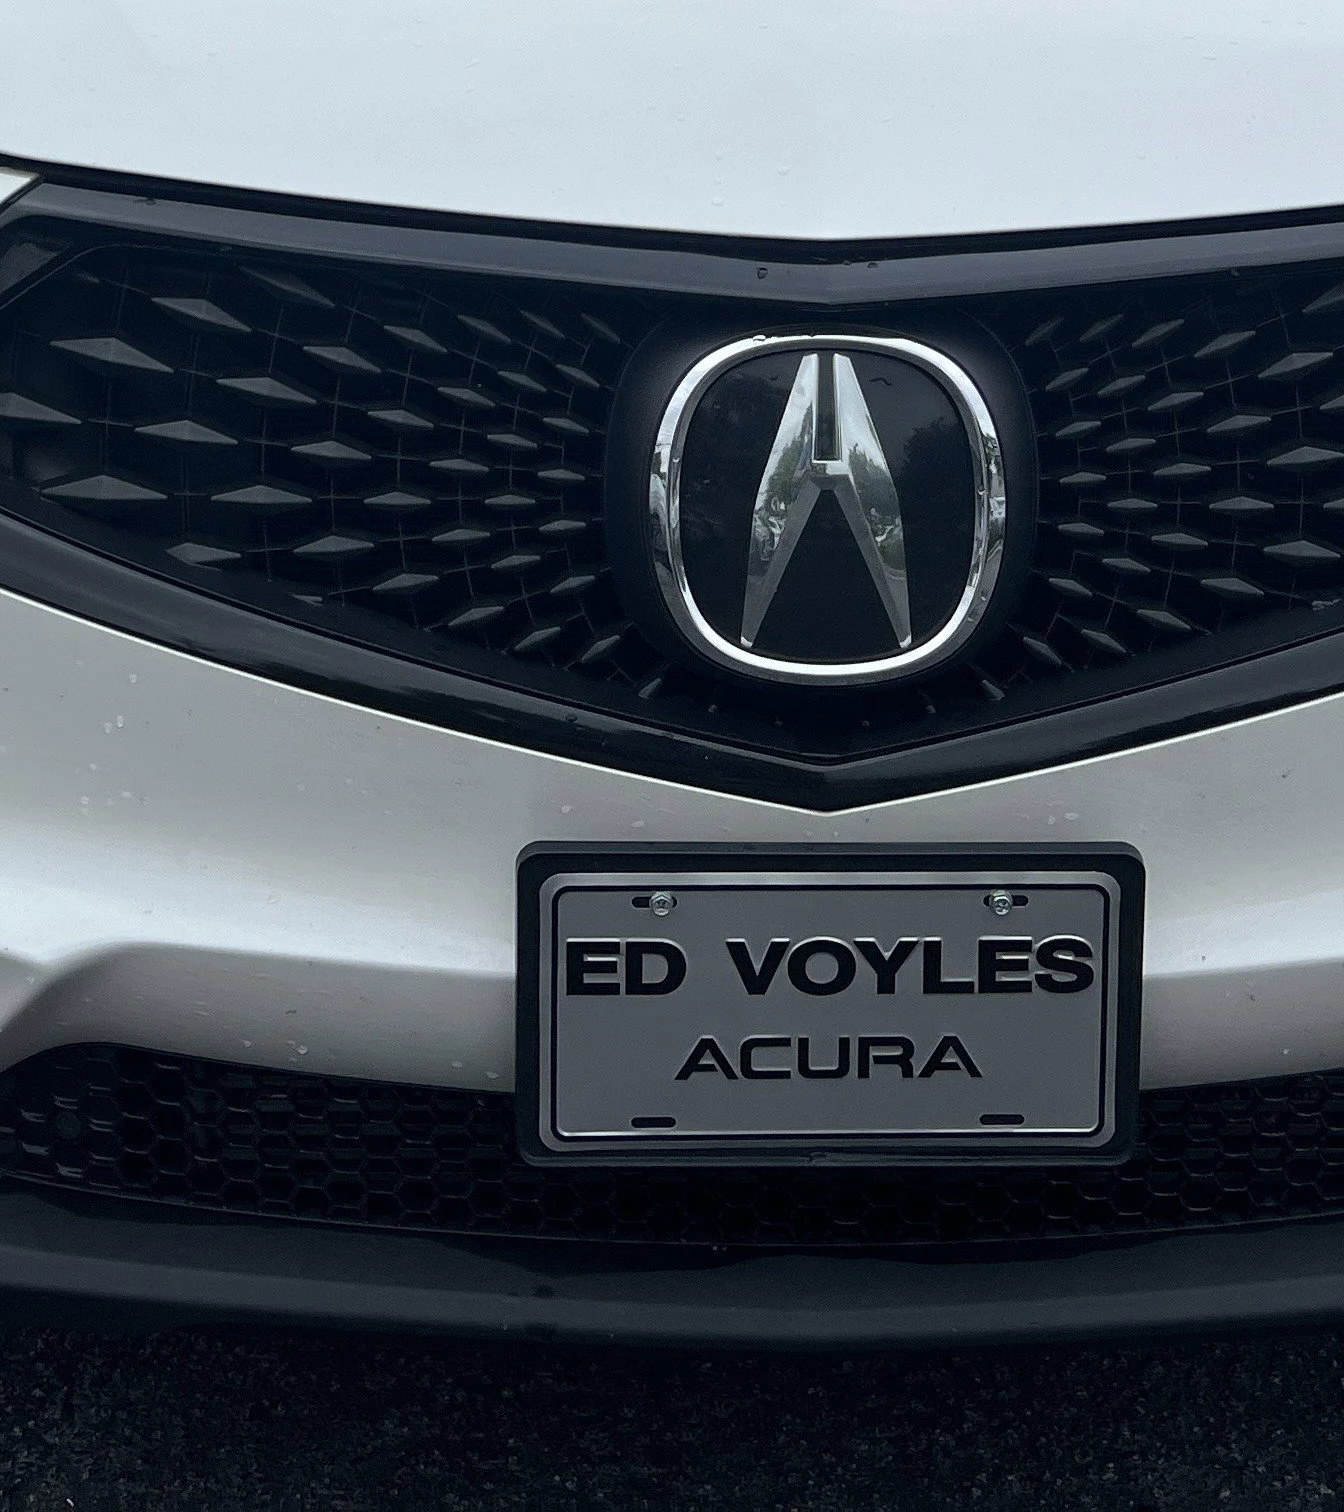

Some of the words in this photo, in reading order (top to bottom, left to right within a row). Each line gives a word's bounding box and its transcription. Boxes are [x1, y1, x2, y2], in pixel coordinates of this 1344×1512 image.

[565, 937, 688, 997] ED
[724, 934, 1095, 997] VOYLES
[674, 1034, 984, 1081] ACURA
